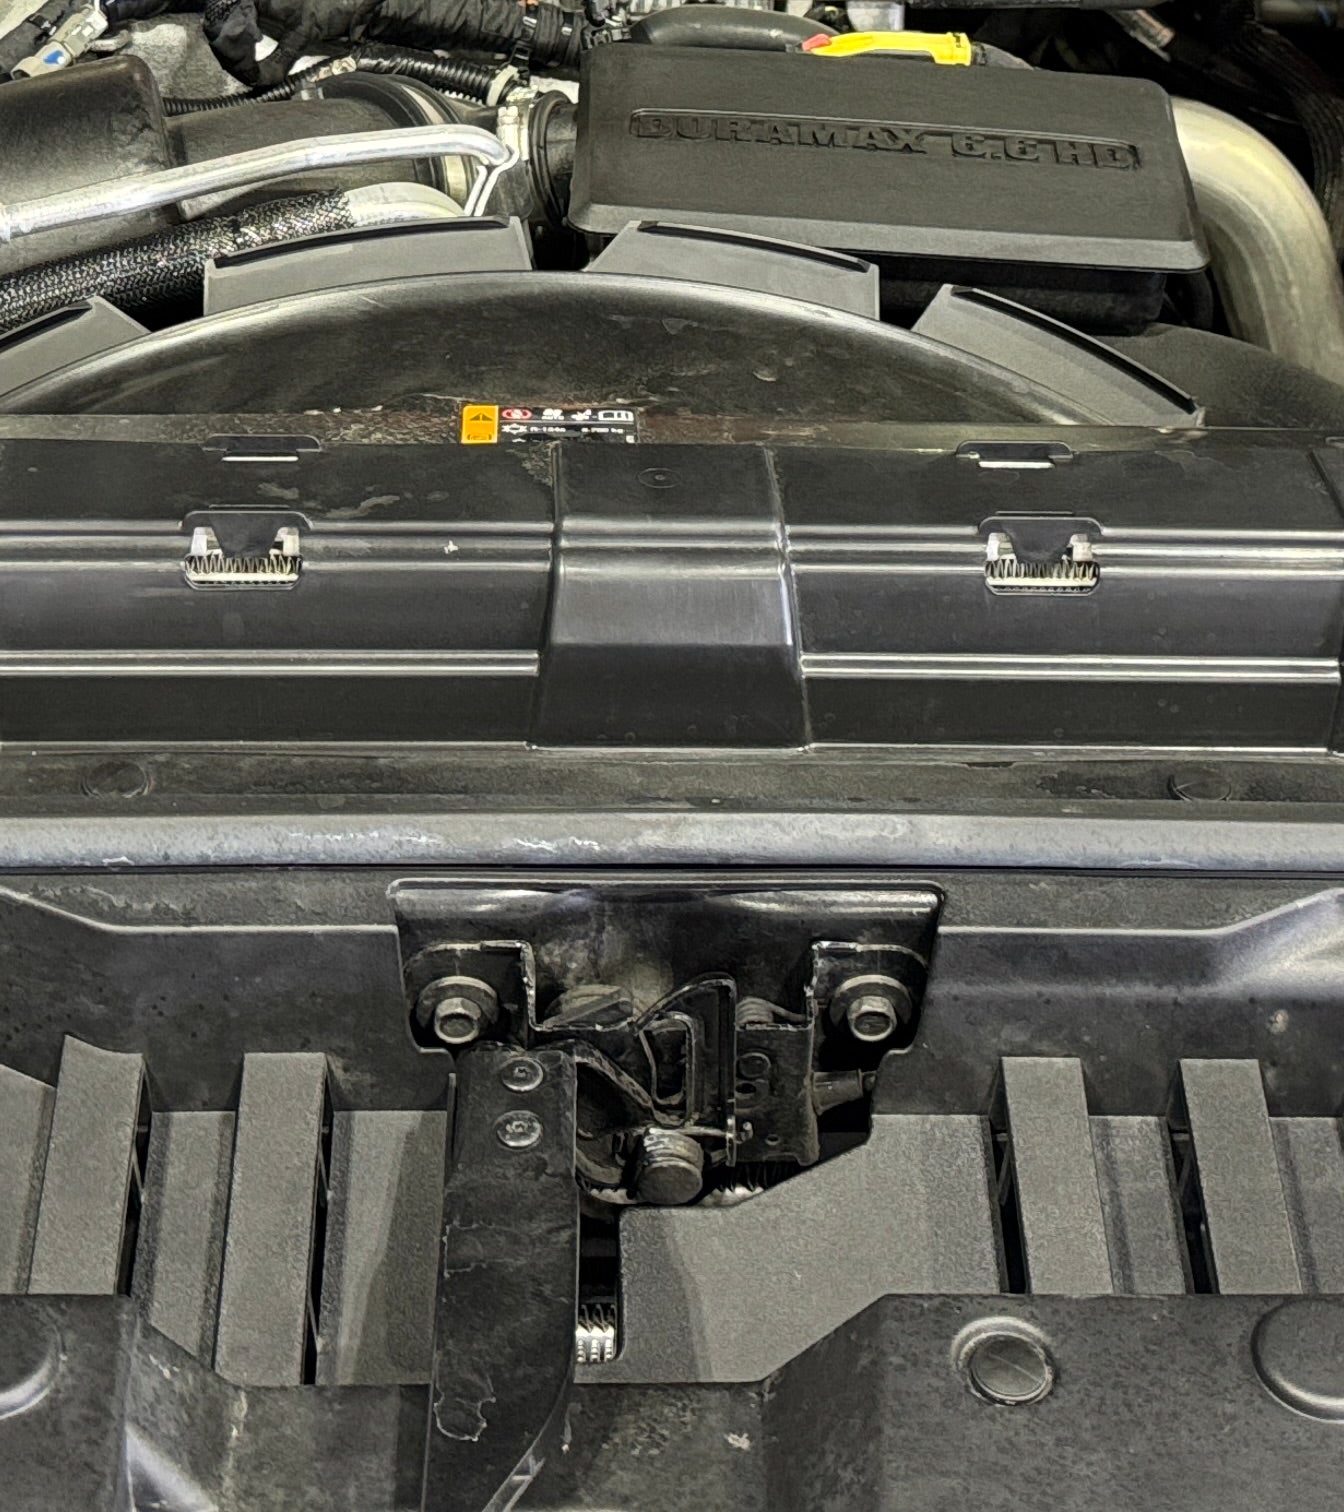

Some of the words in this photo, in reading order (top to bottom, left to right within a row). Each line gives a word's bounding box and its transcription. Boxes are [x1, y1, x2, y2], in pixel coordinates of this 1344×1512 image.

[634, 115, 927, 154] DURAMAX
[951, 133, 1040, 162] 6.6
[1053, 141, 1139, 171] HD
